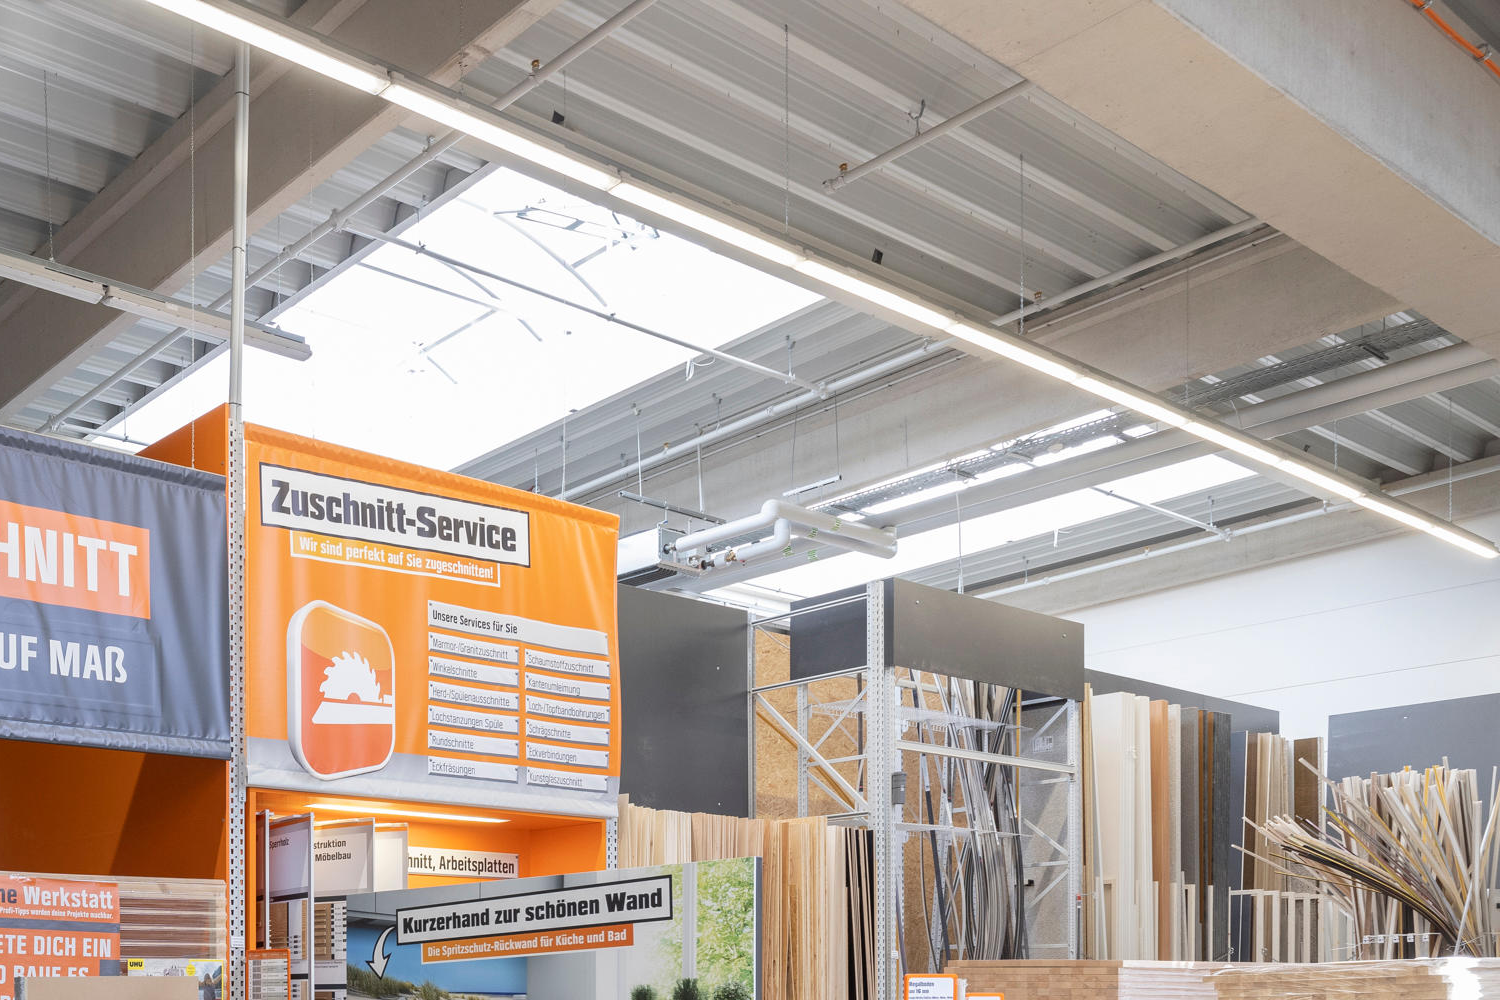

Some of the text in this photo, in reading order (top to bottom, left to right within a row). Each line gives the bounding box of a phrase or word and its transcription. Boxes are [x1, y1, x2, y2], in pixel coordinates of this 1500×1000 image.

[271, 479, 517, 552] Zuschnitt-Service
[299, 537, 494, 580] Wir sind perfekt auf Sie zugeschnitten!
[432, 610, 518, 634] Unsere Services für Sie
[49, 640, 128, 684] MAß
[432, 662, 478, 678] Winkelschnitte
[528, 655, 594, 673] Schaumstoffzuschnitt
[528, 678, 581, 697] Kantenumleimung
[432, 713, 483, 728] Lochstanzungen
[432, 736, 474, 750] Rundschnitte
[314, 839, 346, 849] struktion
[315, 852, 351, 861] Möbelbau
[439, 856, 515, 876] Arbeitsplatten
[23, 886, 114, 909] Werkstatt
[0, 906, 30, 917] Profi-Tipps
[30, 908, 51, 916] werden
[51, 909, 66, 917] deine
[67, 910, 90, 919] Projekte
[402, 888, 662, 934] Kurzerhand zur schönen Wand
[33, 935, 76, 957] DICH
[82, 937, 112, 958] EIN
[428, 929, 627, 957] Die Spritzschutz-Rückwand für Küche und Bad
